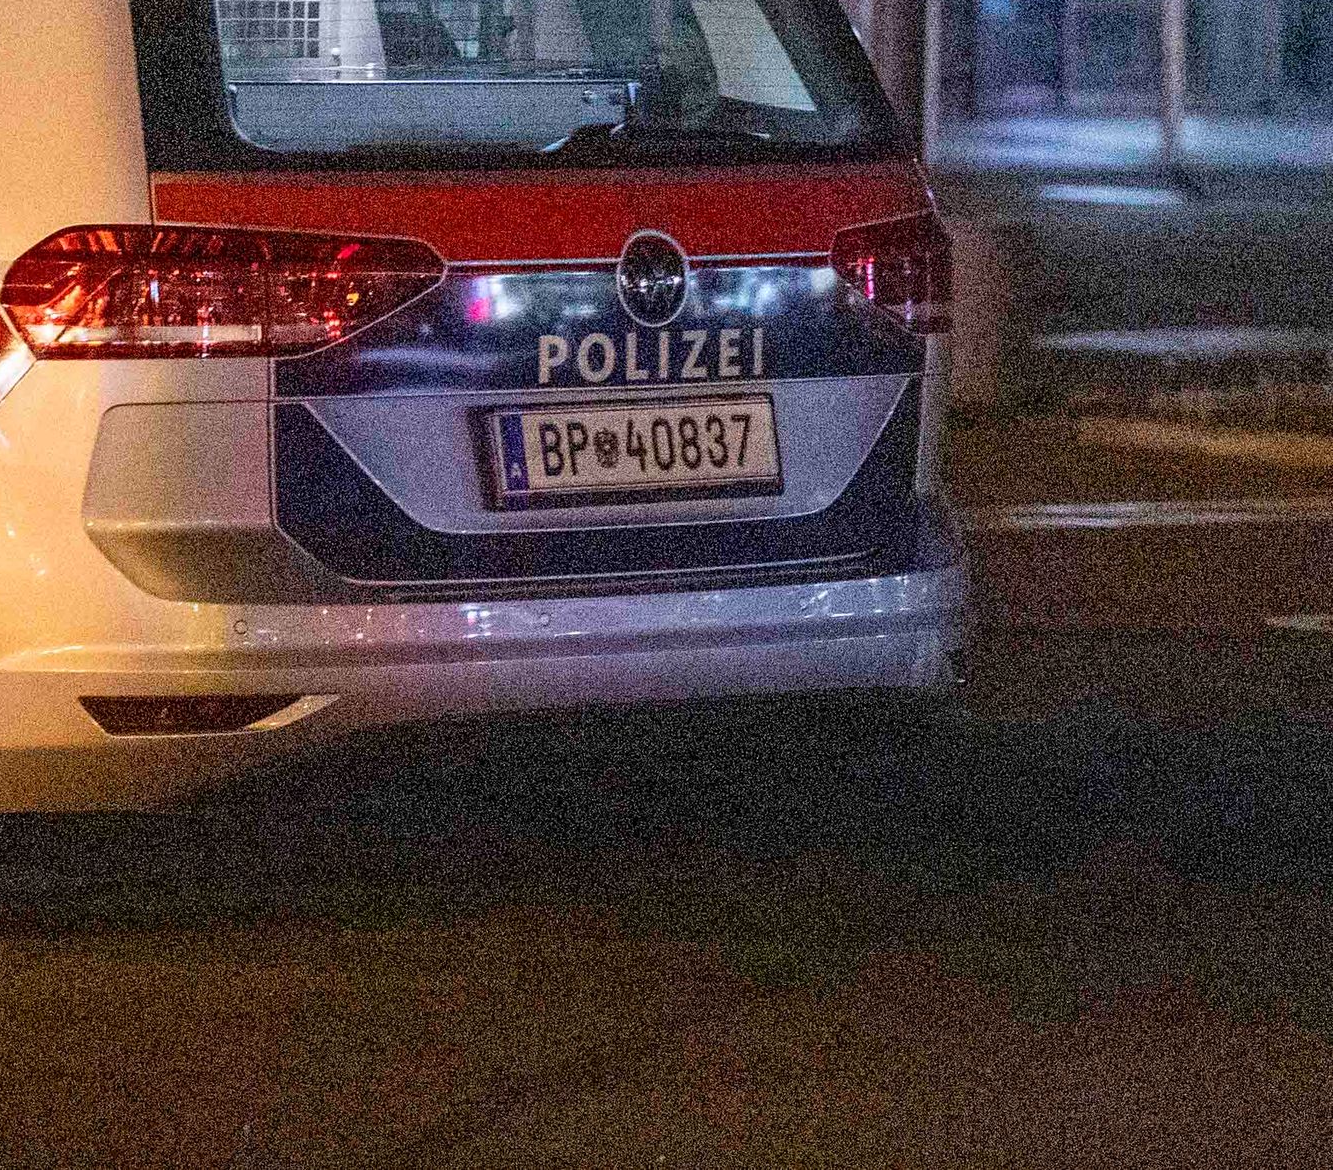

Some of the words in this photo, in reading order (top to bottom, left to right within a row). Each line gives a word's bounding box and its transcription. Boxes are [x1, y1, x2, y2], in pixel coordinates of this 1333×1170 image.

[537, 328, 765, 383] POLIZEI
[539, 420, 590, 477] BP
[625, 413, 753, 473] 40837
